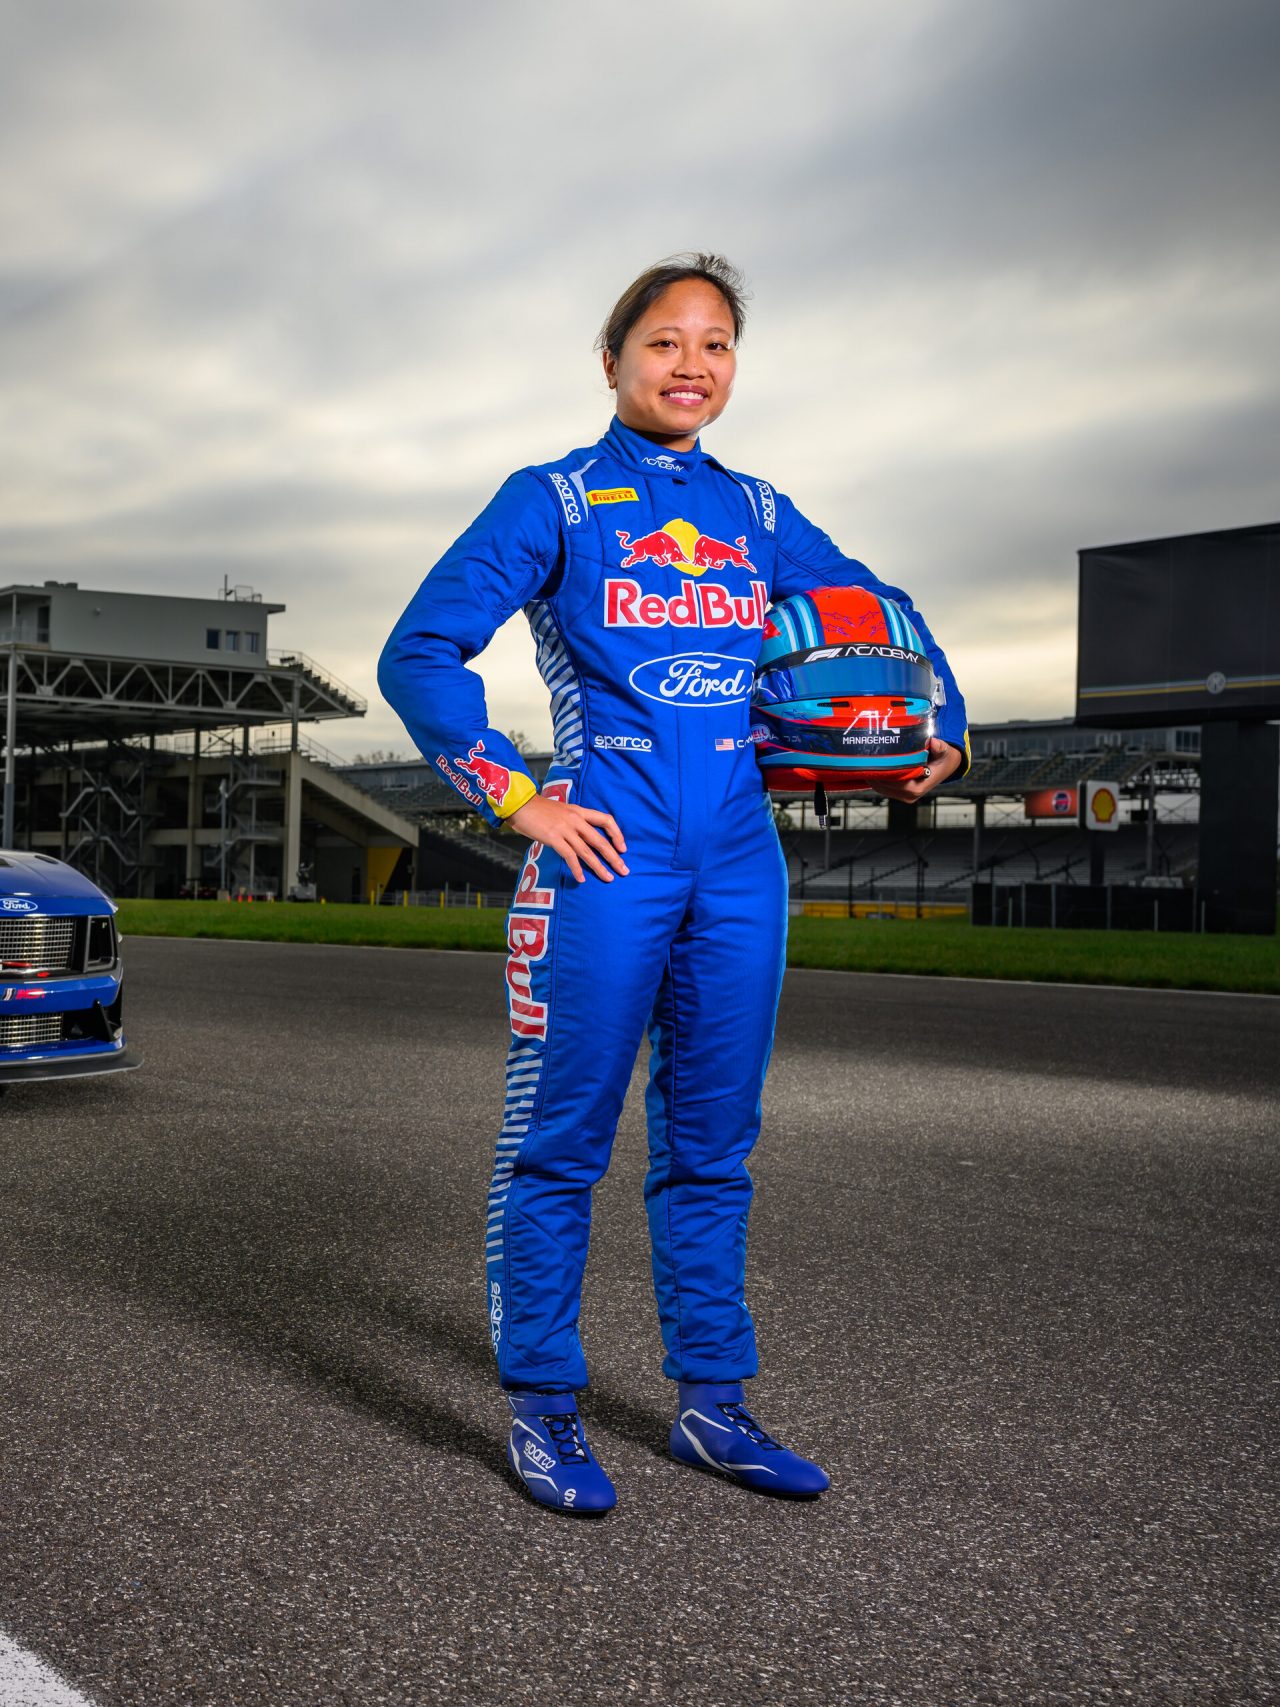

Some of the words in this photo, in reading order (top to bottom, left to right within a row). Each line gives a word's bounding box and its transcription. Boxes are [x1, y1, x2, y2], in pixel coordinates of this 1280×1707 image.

[641, 457, 685, 472] ACADEMY
[548, 472, 581, 526] sparco
[591, 490, 634, 502] PIRELLI
[756, 481, 776, 533] sparco
[845, 646, 919, 663] ACADEMY
[660, 660, 746, 697] Ford
[594, 735, 652, 752] sparco
[842, 736, 900, 745] MANAGEMENT
[2, 900, 31, 910] Ford
[523, 1440, 556, 1473] sparco
